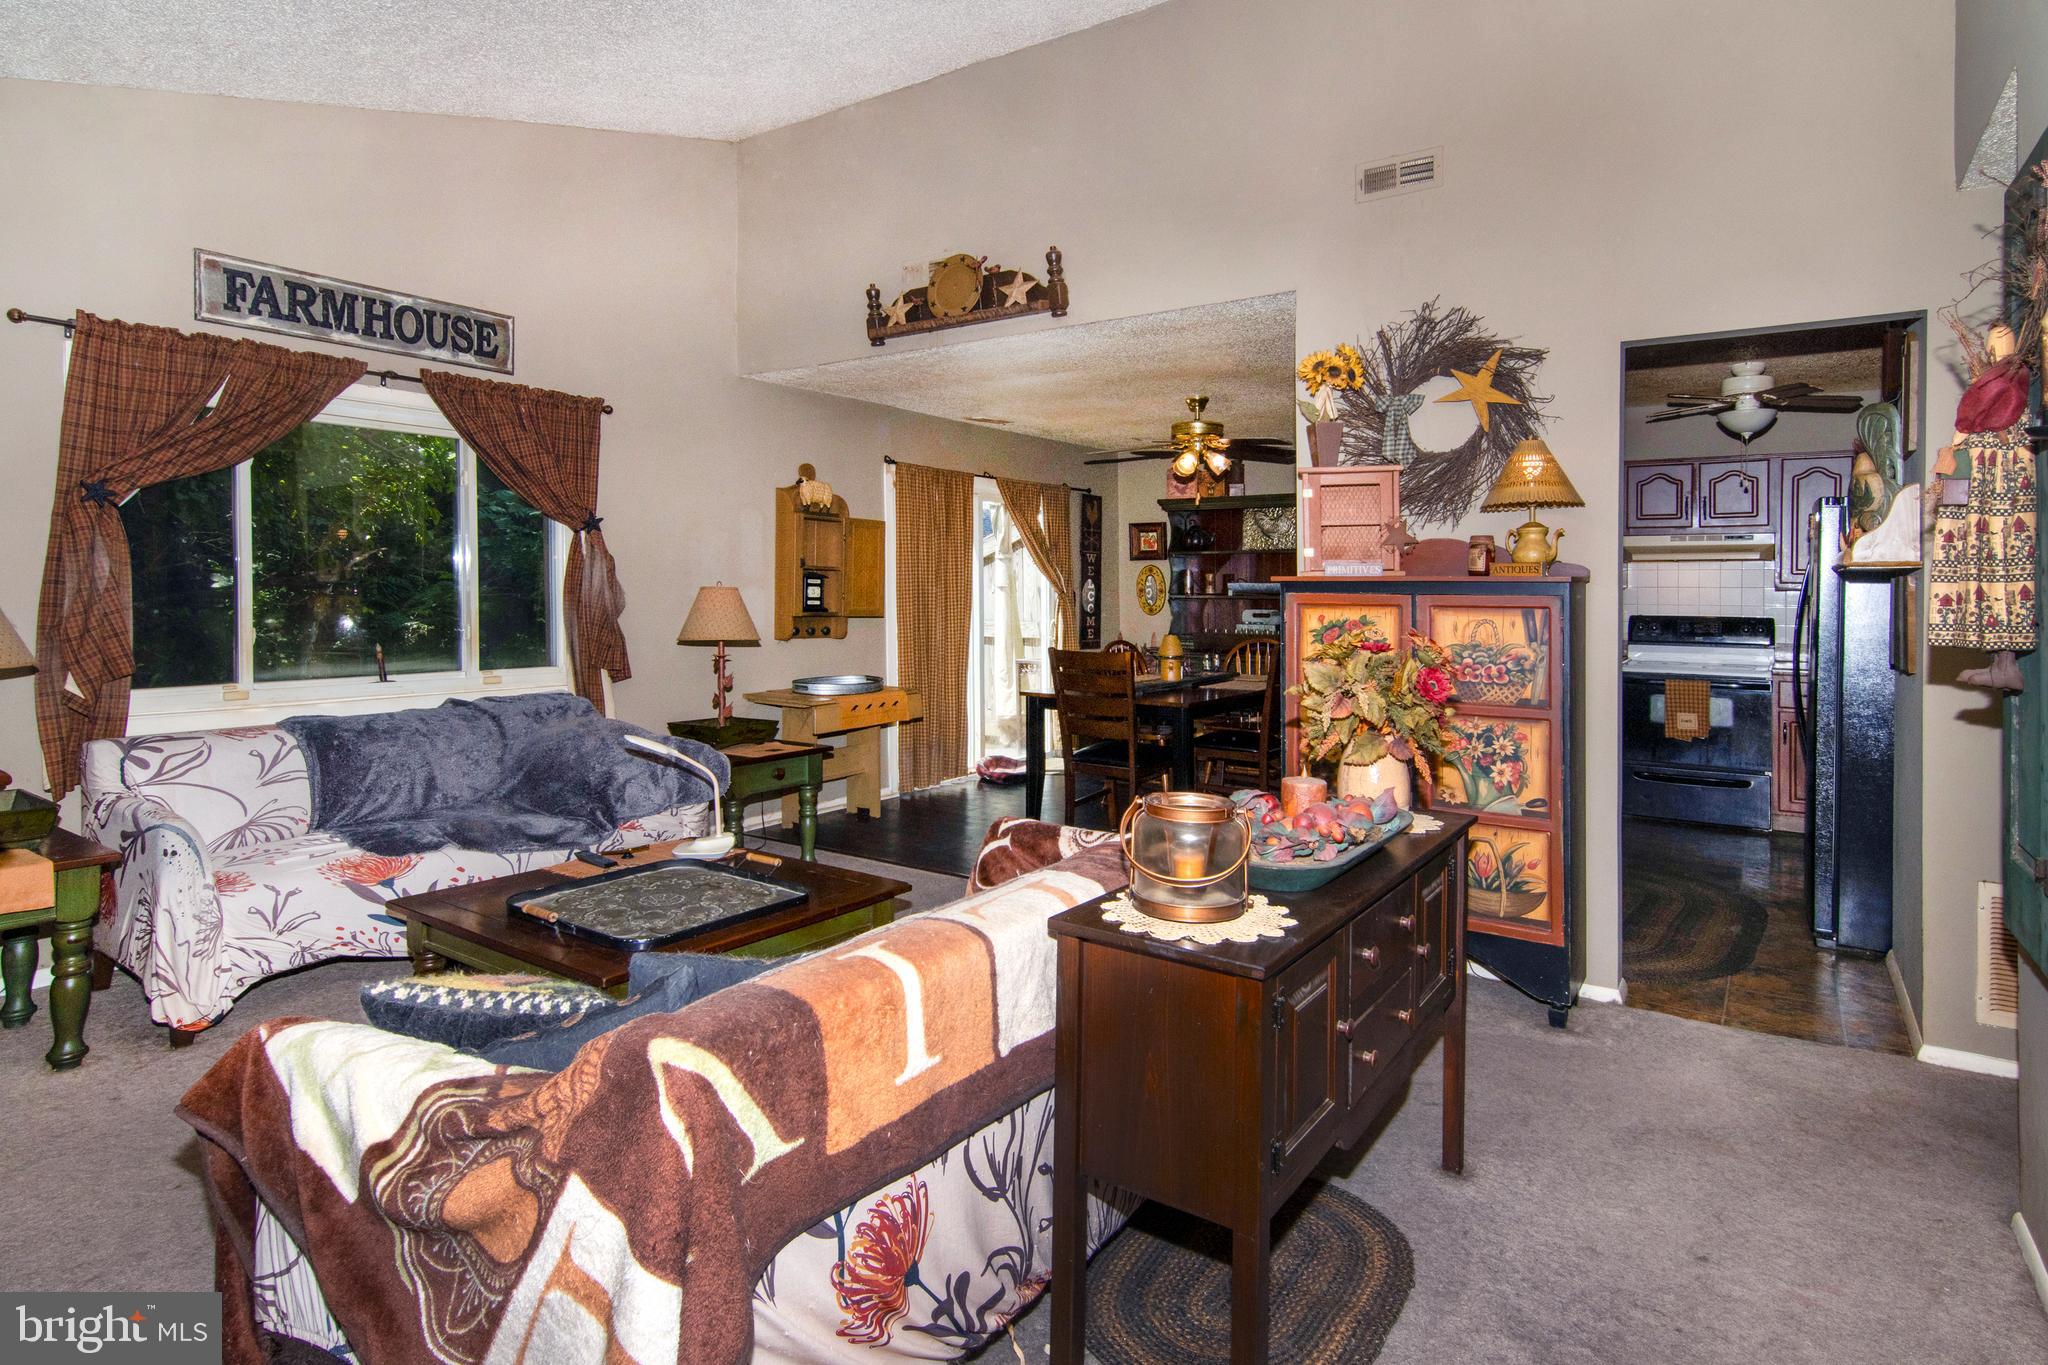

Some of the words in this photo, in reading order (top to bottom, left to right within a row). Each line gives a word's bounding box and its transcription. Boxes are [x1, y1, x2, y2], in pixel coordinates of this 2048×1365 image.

[222, 267, 499, 359] FARMHOUSE
[1327, 565, 1383, 575] PRIMITIVES
[1493, 565, 1540, 575] ANTIQUES
[1086, 553, 1096, 639] WELCOME
